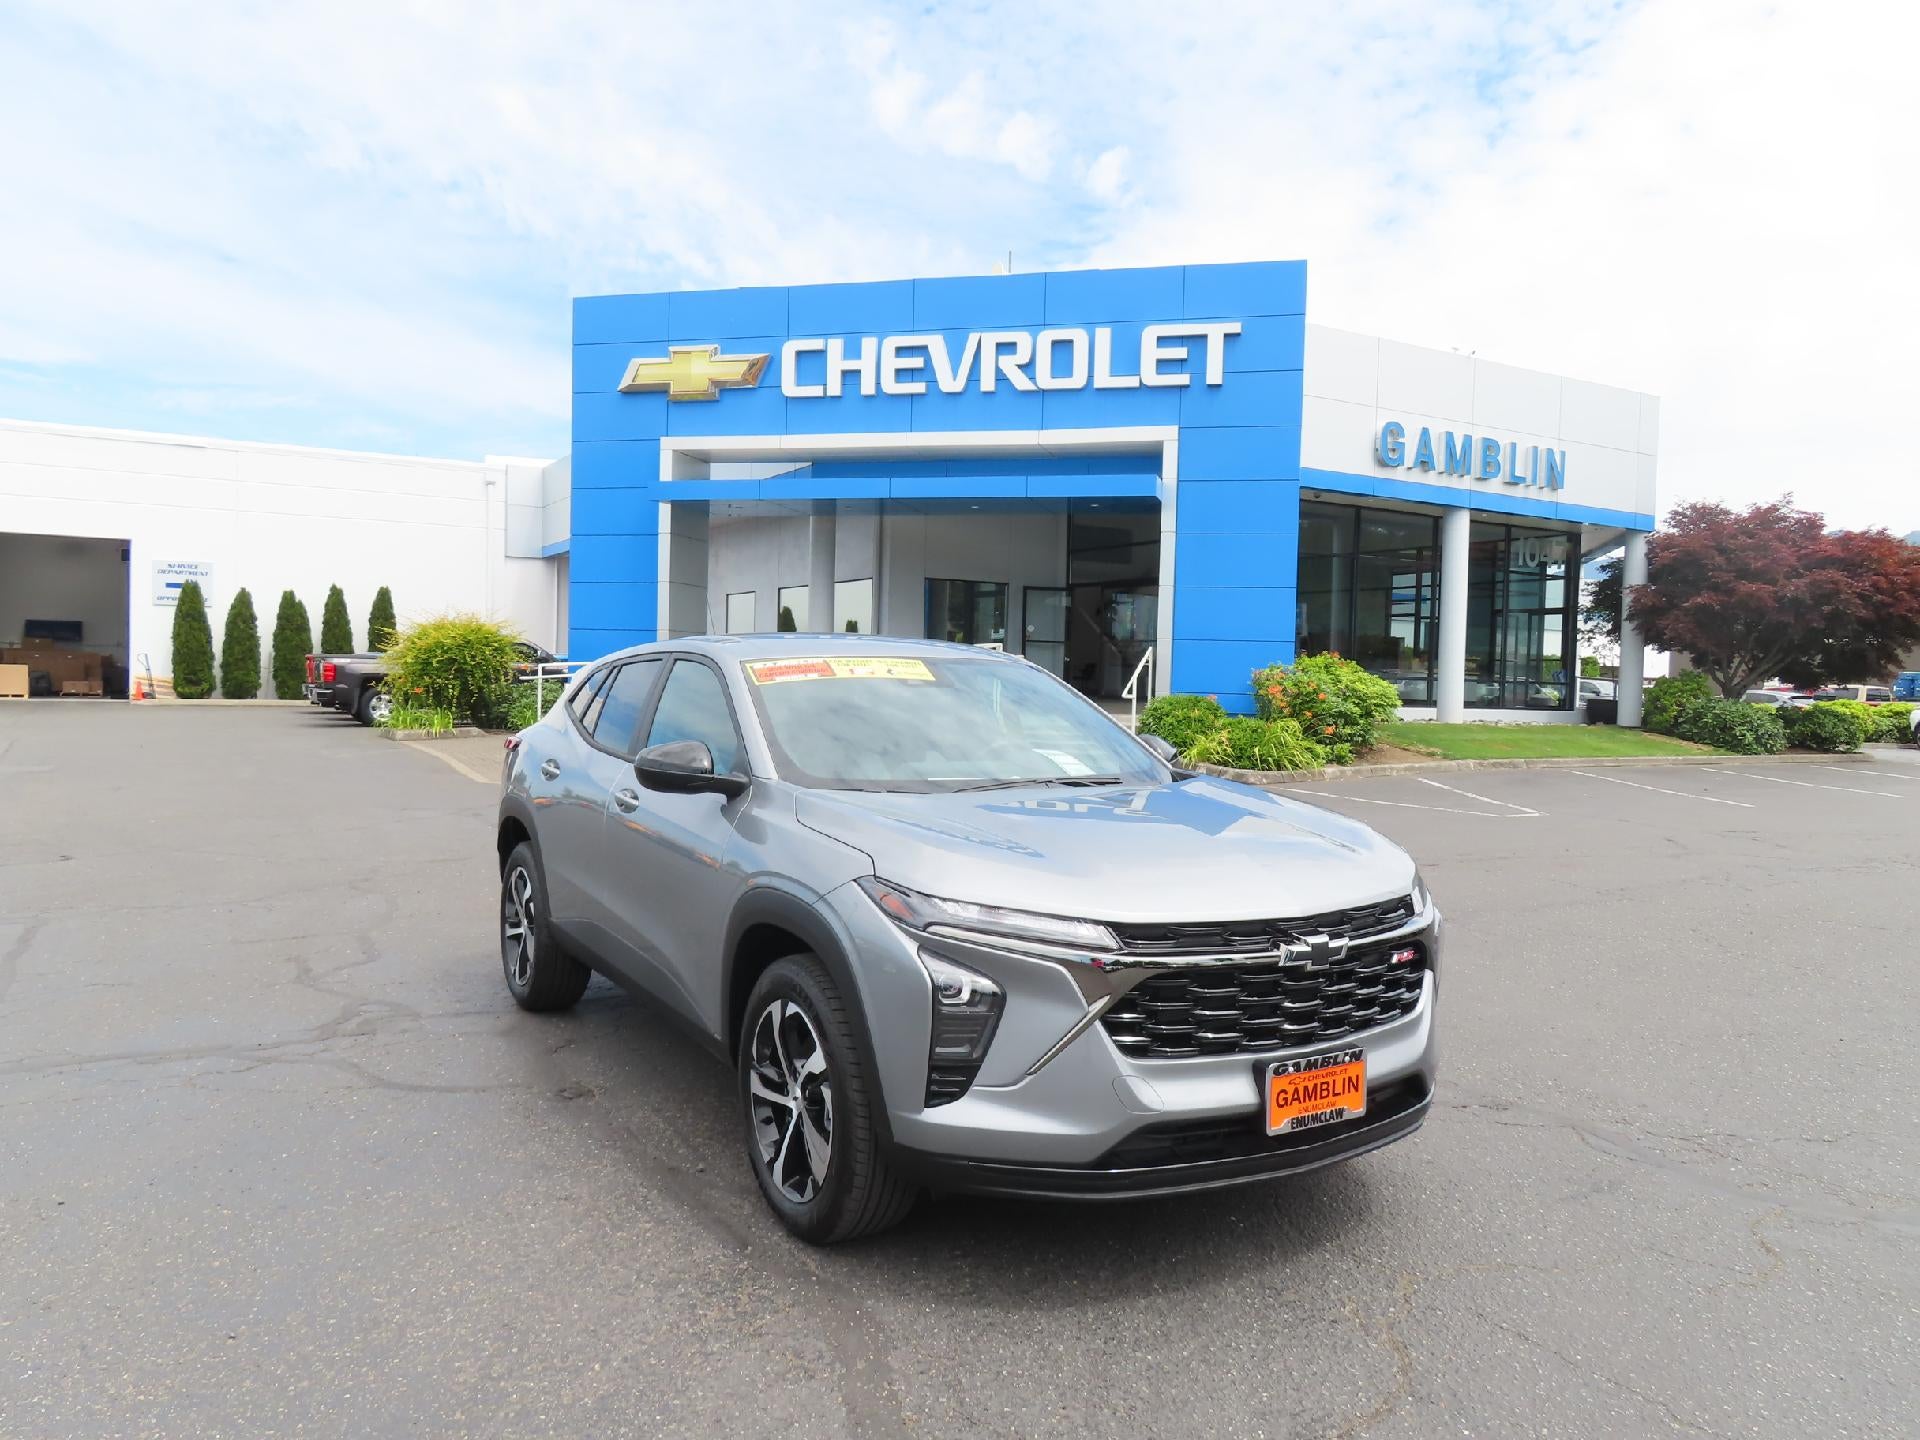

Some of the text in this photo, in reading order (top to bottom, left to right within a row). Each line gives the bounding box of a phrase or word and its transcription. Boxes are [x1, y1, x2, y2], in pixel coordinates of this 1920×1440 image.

[780, 322, 1242, 398] CHEVROLET
[1375, 420, 1566, 490] GAMBLIN
[1272, 1049, 1364, 1076] GAMBLIN
[1307, 1068, 1348, 1083] CHEVROLET
[1275, 1074, 1360, 1109] GAMBLIN
[1289, 1107, 1345, 1130] ENUMCLAW
